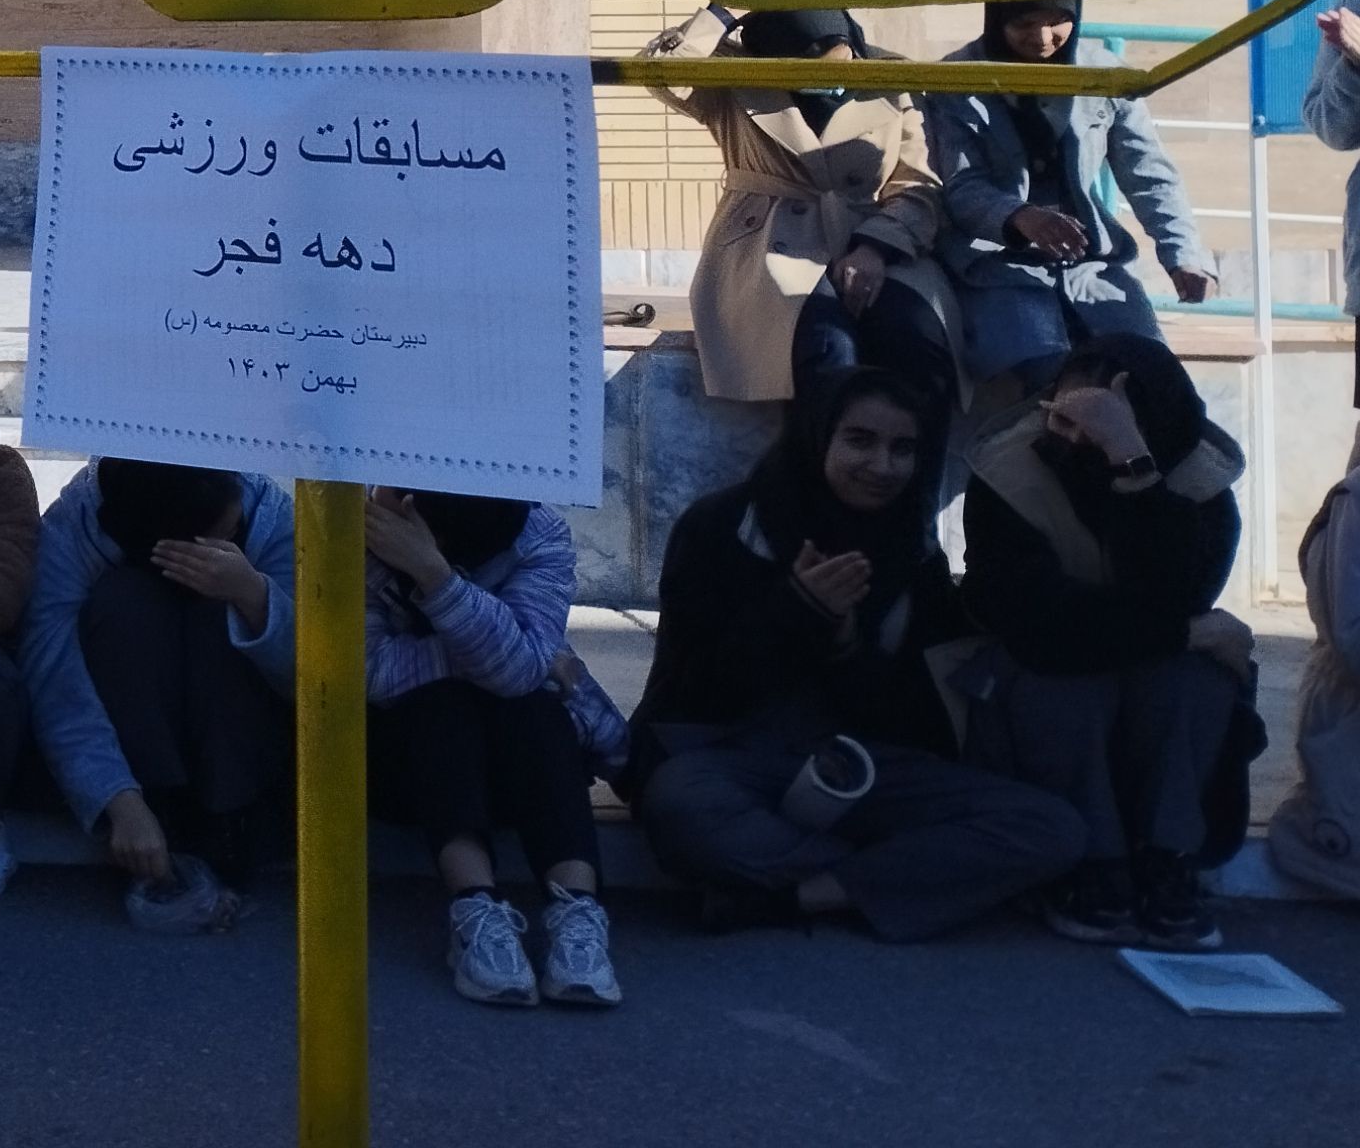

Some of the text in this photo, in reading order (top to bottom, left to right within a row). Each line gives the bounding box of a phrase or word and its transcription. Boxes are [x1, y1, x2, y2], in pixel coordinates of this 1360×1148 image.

[112, 111, 507, 181] مسابقات ورزشی
[194, 216, 396, 276] دهه فجر
[164, 308, 427, 349] دبیرستان حضرت معصومه (س)
[227, 356, 357, 395] بهمن ۱۴۰۳
